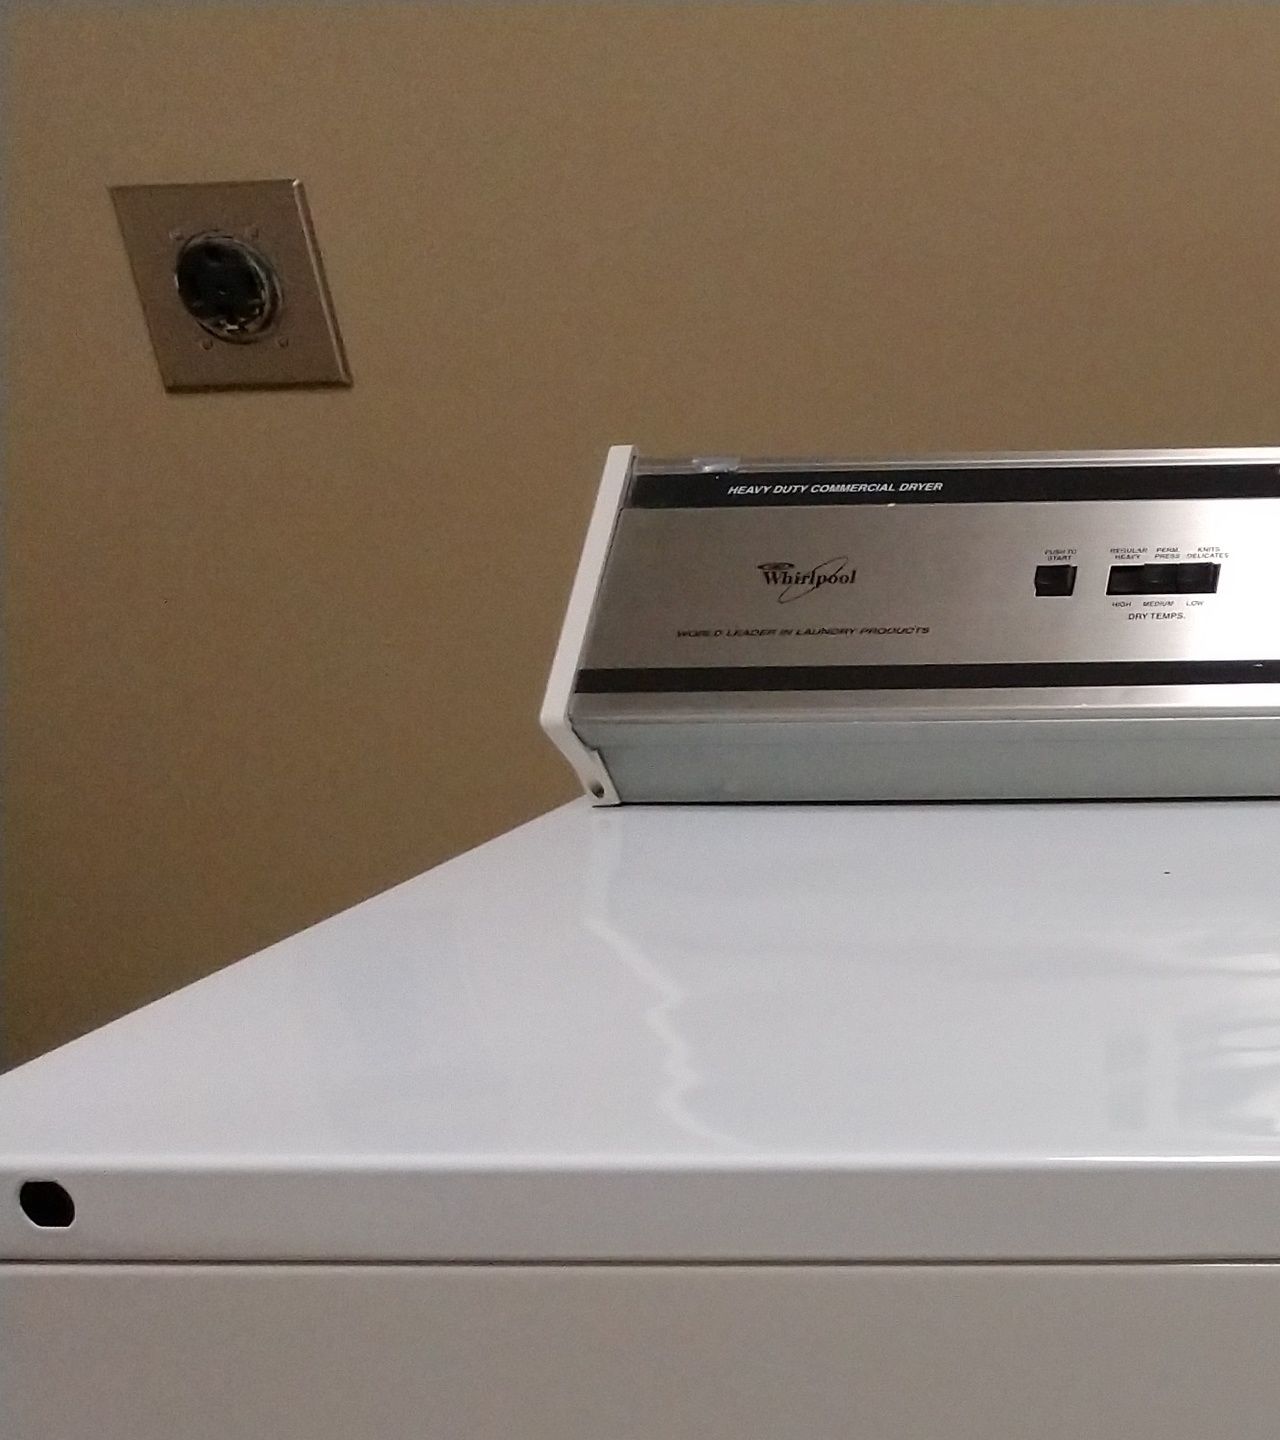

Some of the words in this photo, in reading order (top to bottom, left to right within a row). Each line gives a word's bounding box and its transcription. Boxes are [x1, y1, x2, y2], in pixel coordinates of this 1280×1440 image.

[727, 486, 772, 495] HEAVY
[772, 485, 808, 494] DUTY
[810, 483, 896, 493] COMMERCIAL
[899, 482, 944, 492] DRYER
[1128, 612, 1148, 620] DRY
[726, 629, 776, 637] LEADER
[795, 627, 854, 636] LAUNDRY
[860, 626, 930, 635] PRODUCTS
